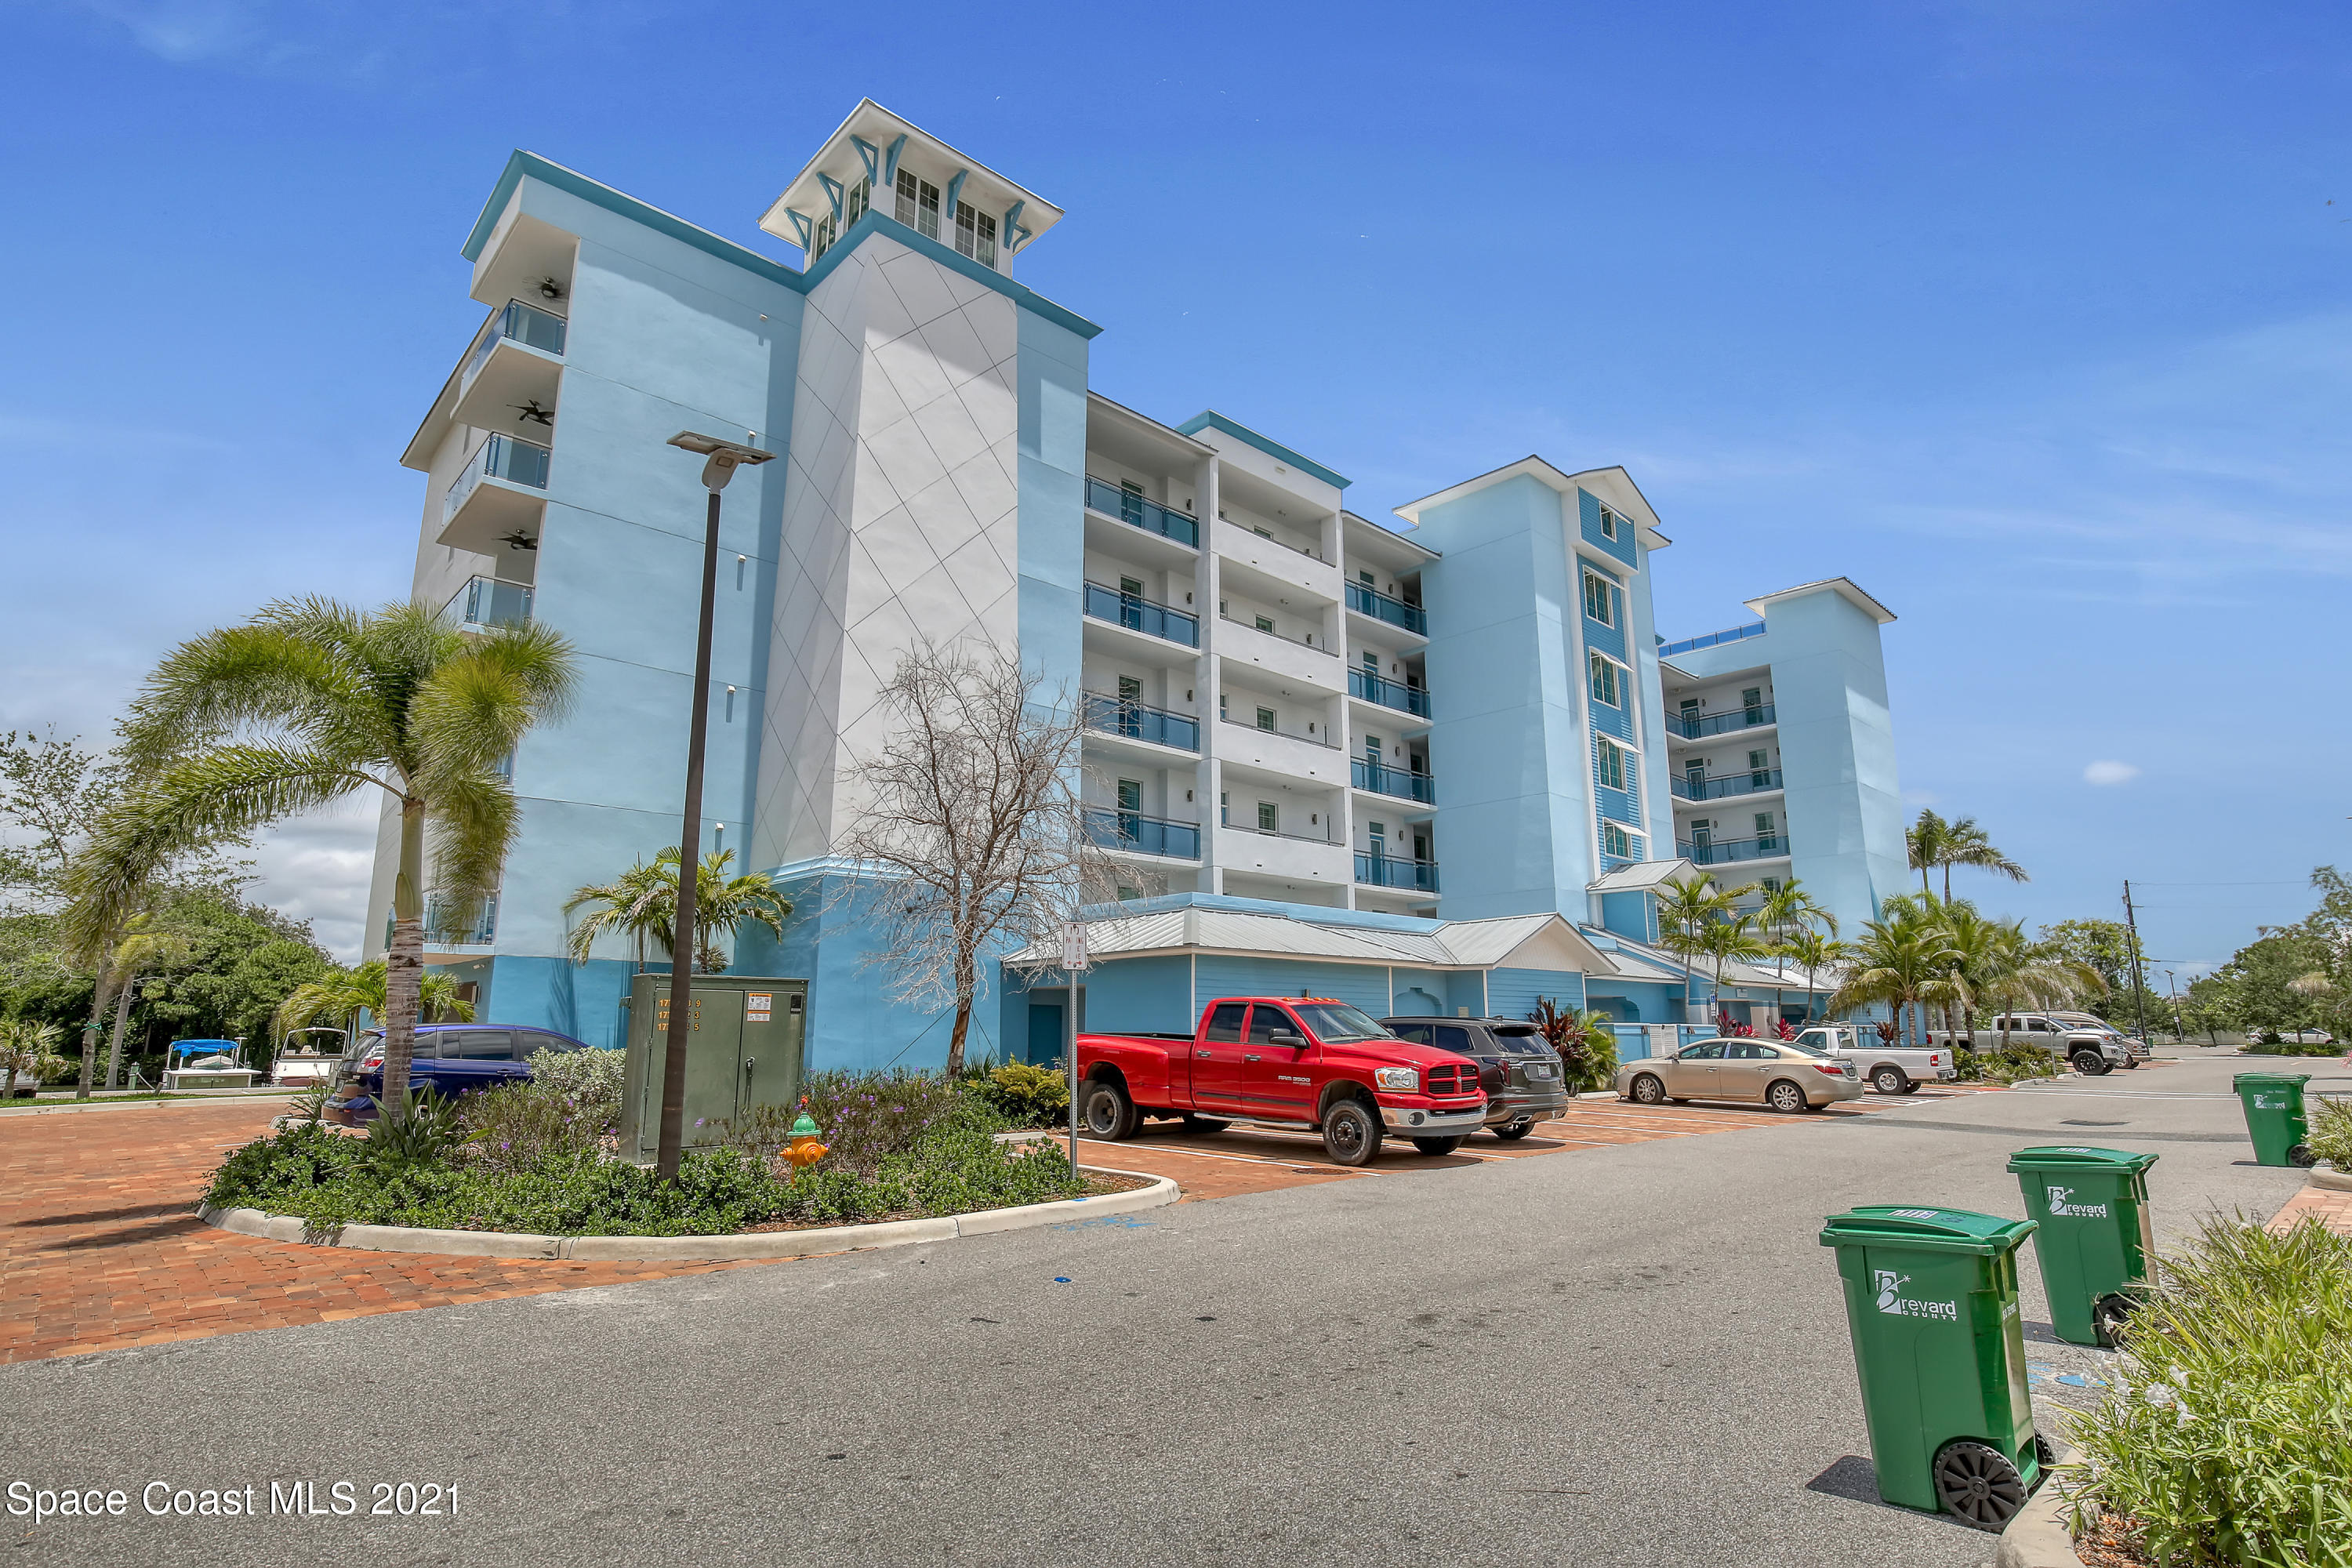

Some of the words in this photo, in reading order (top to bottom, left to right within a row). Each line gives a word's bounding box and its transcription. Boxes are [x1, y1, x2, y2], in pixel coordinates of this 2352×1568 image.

[2047, 1185, 2107, 1215] Brevard
[1875, 1269, 1957, 1316] Brevard
[1902, 1310, 1958, 1321] COUNTY
